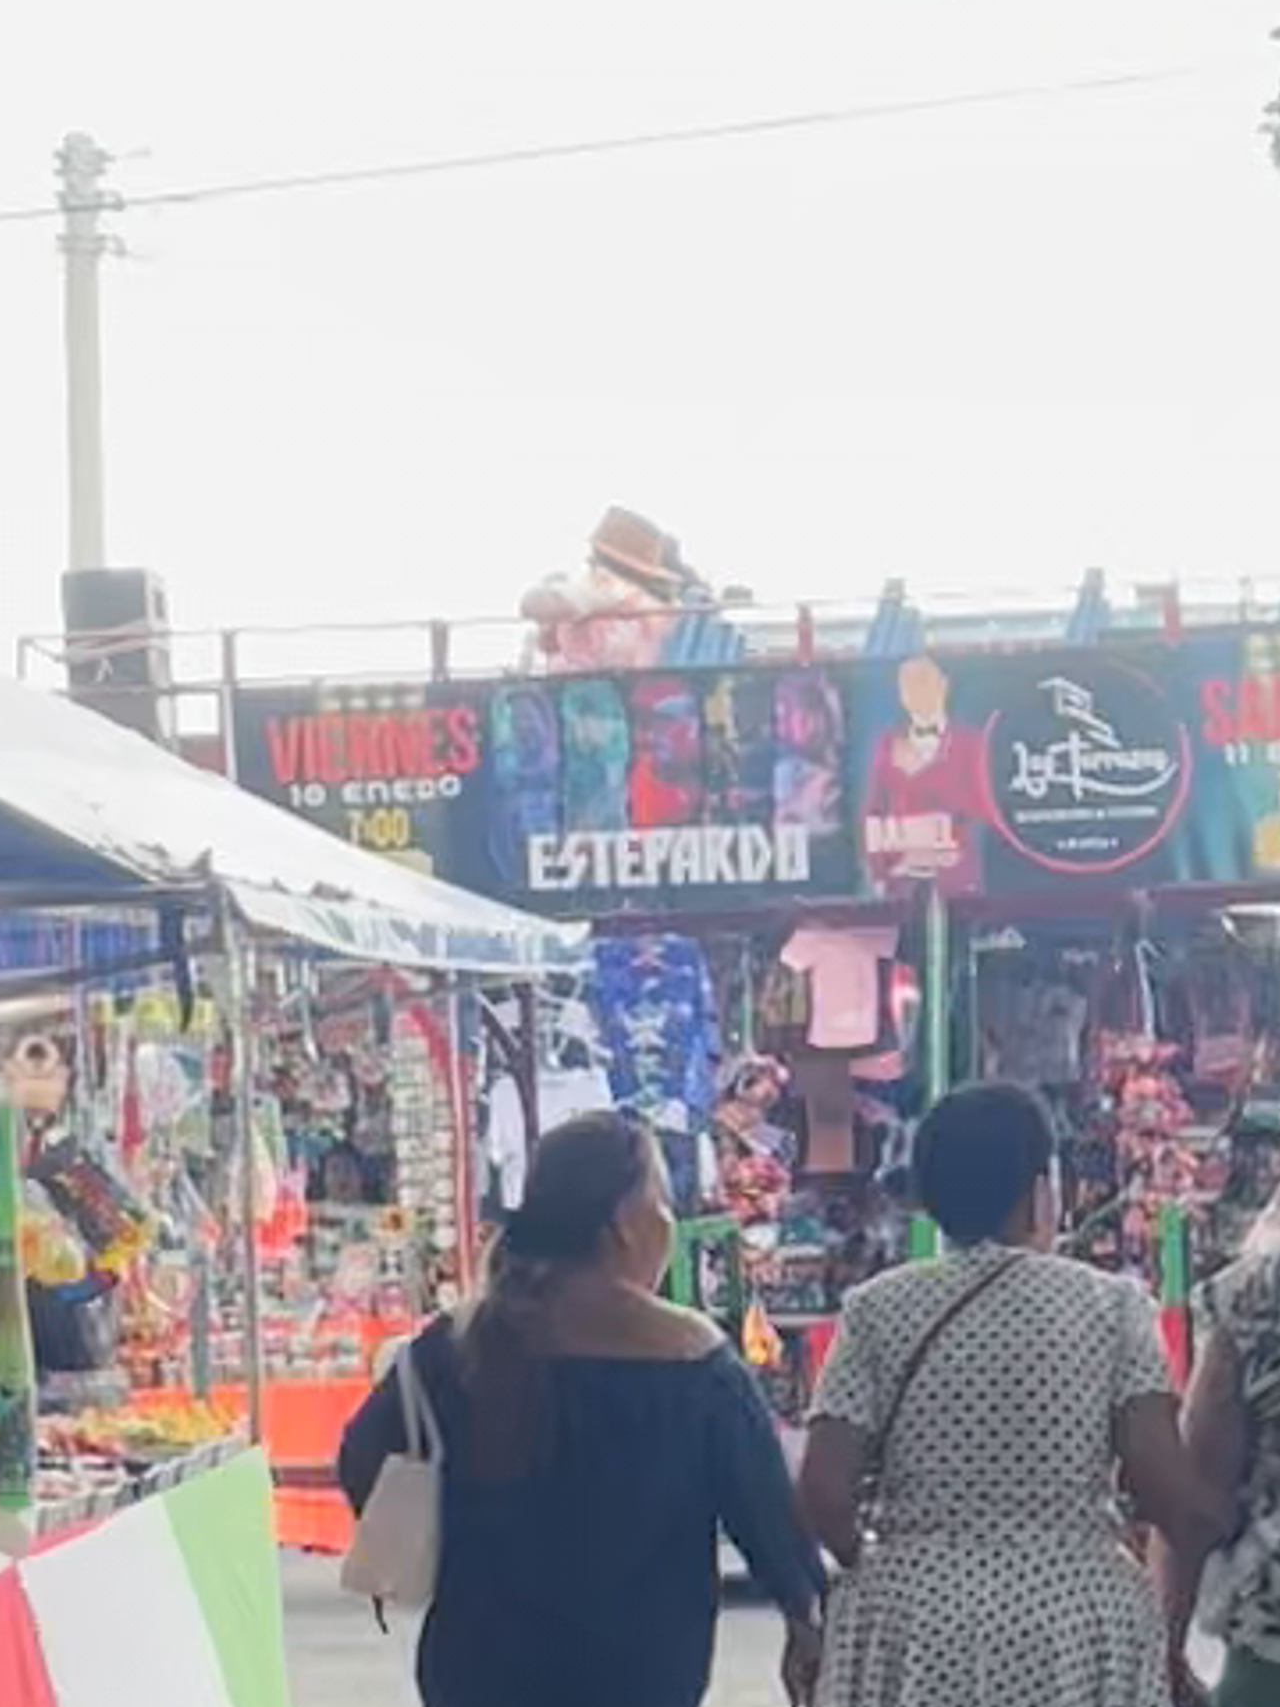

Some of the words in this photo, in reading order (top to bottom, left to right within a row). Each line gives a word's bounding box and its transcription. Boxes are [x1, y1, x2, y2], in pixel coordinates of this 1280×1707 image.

[264, 706, 478, 783] VIERNES
[288, 782, 327, 808] 10
[341, 774, 462, 804] ENERO
